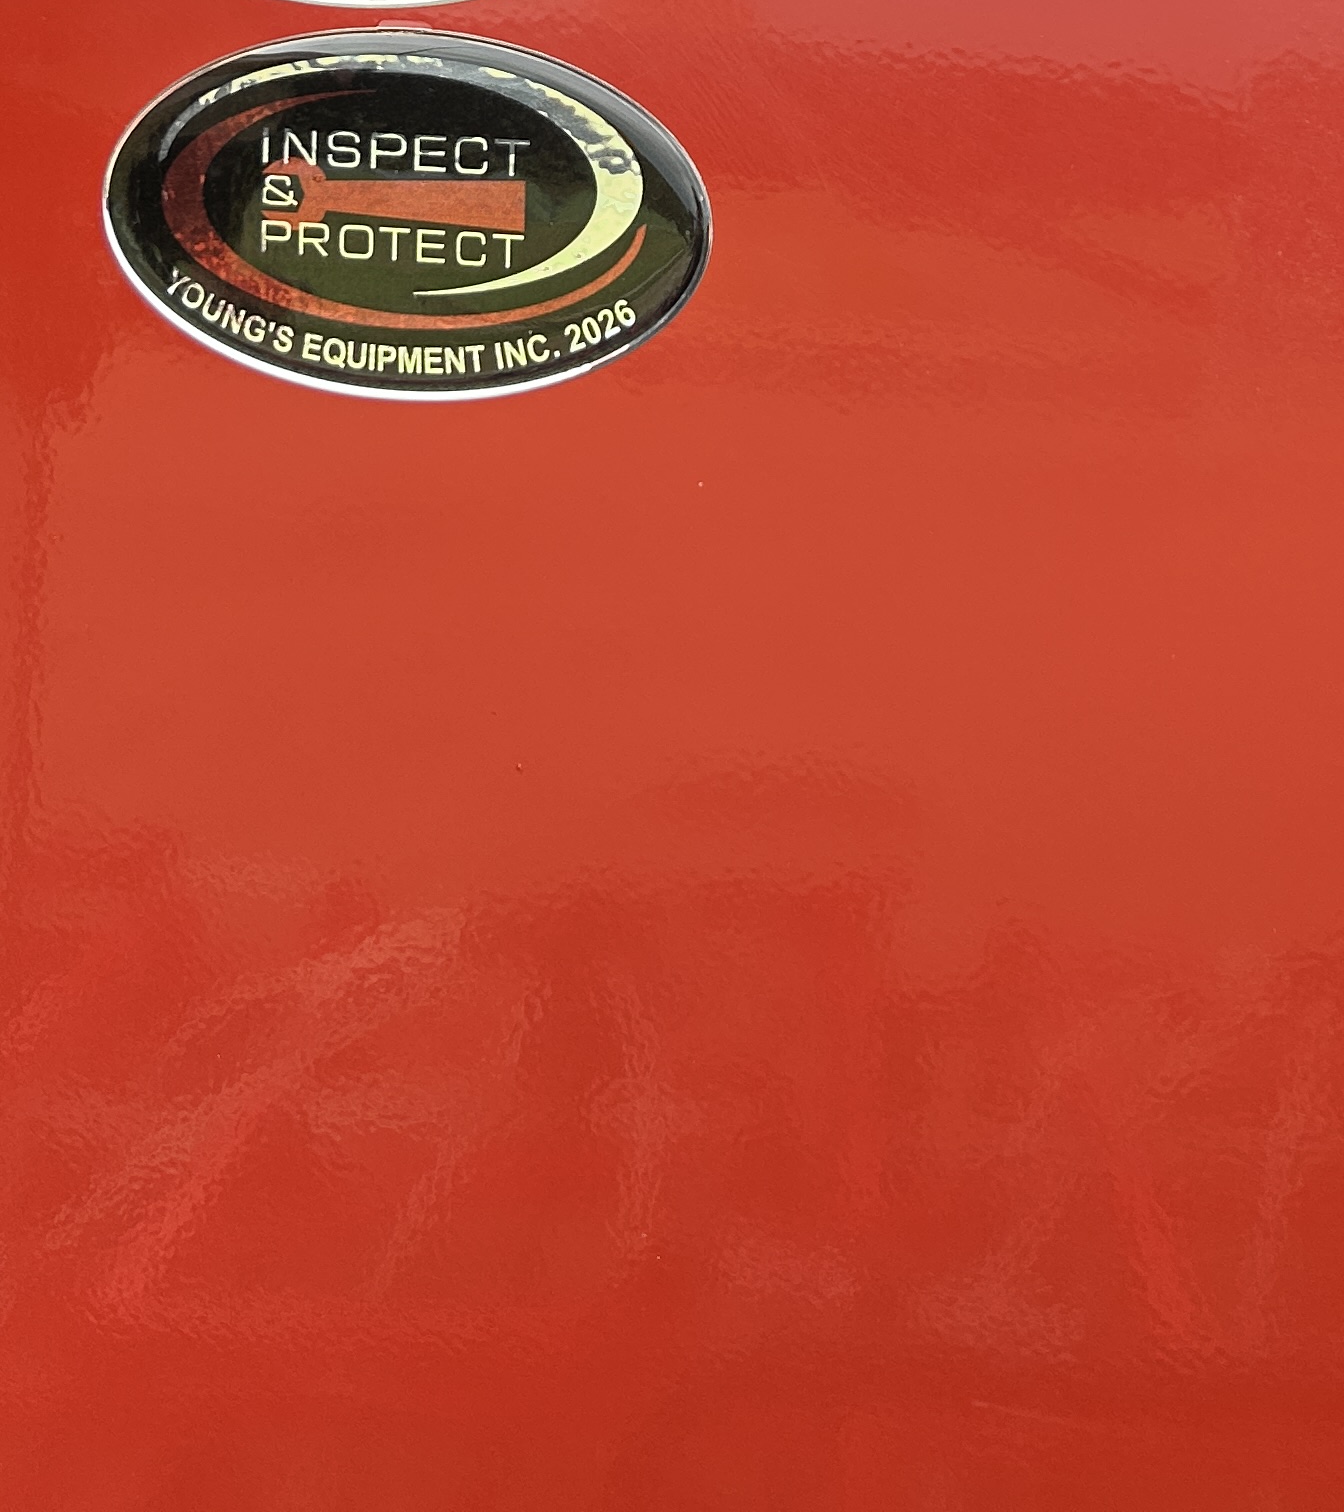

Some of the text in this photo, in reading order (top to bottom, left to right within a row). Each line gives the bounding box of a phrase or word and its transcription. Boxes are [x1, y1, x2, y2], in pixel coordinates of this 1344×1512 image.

[261, 128, 532, 178] INSPECT
[261, 174, 298, 208] &
[260, 219, 526, 270] PROTECT
[164, 268, 639, 376] YOUNG'S EQUIPMENT INC. 2026
